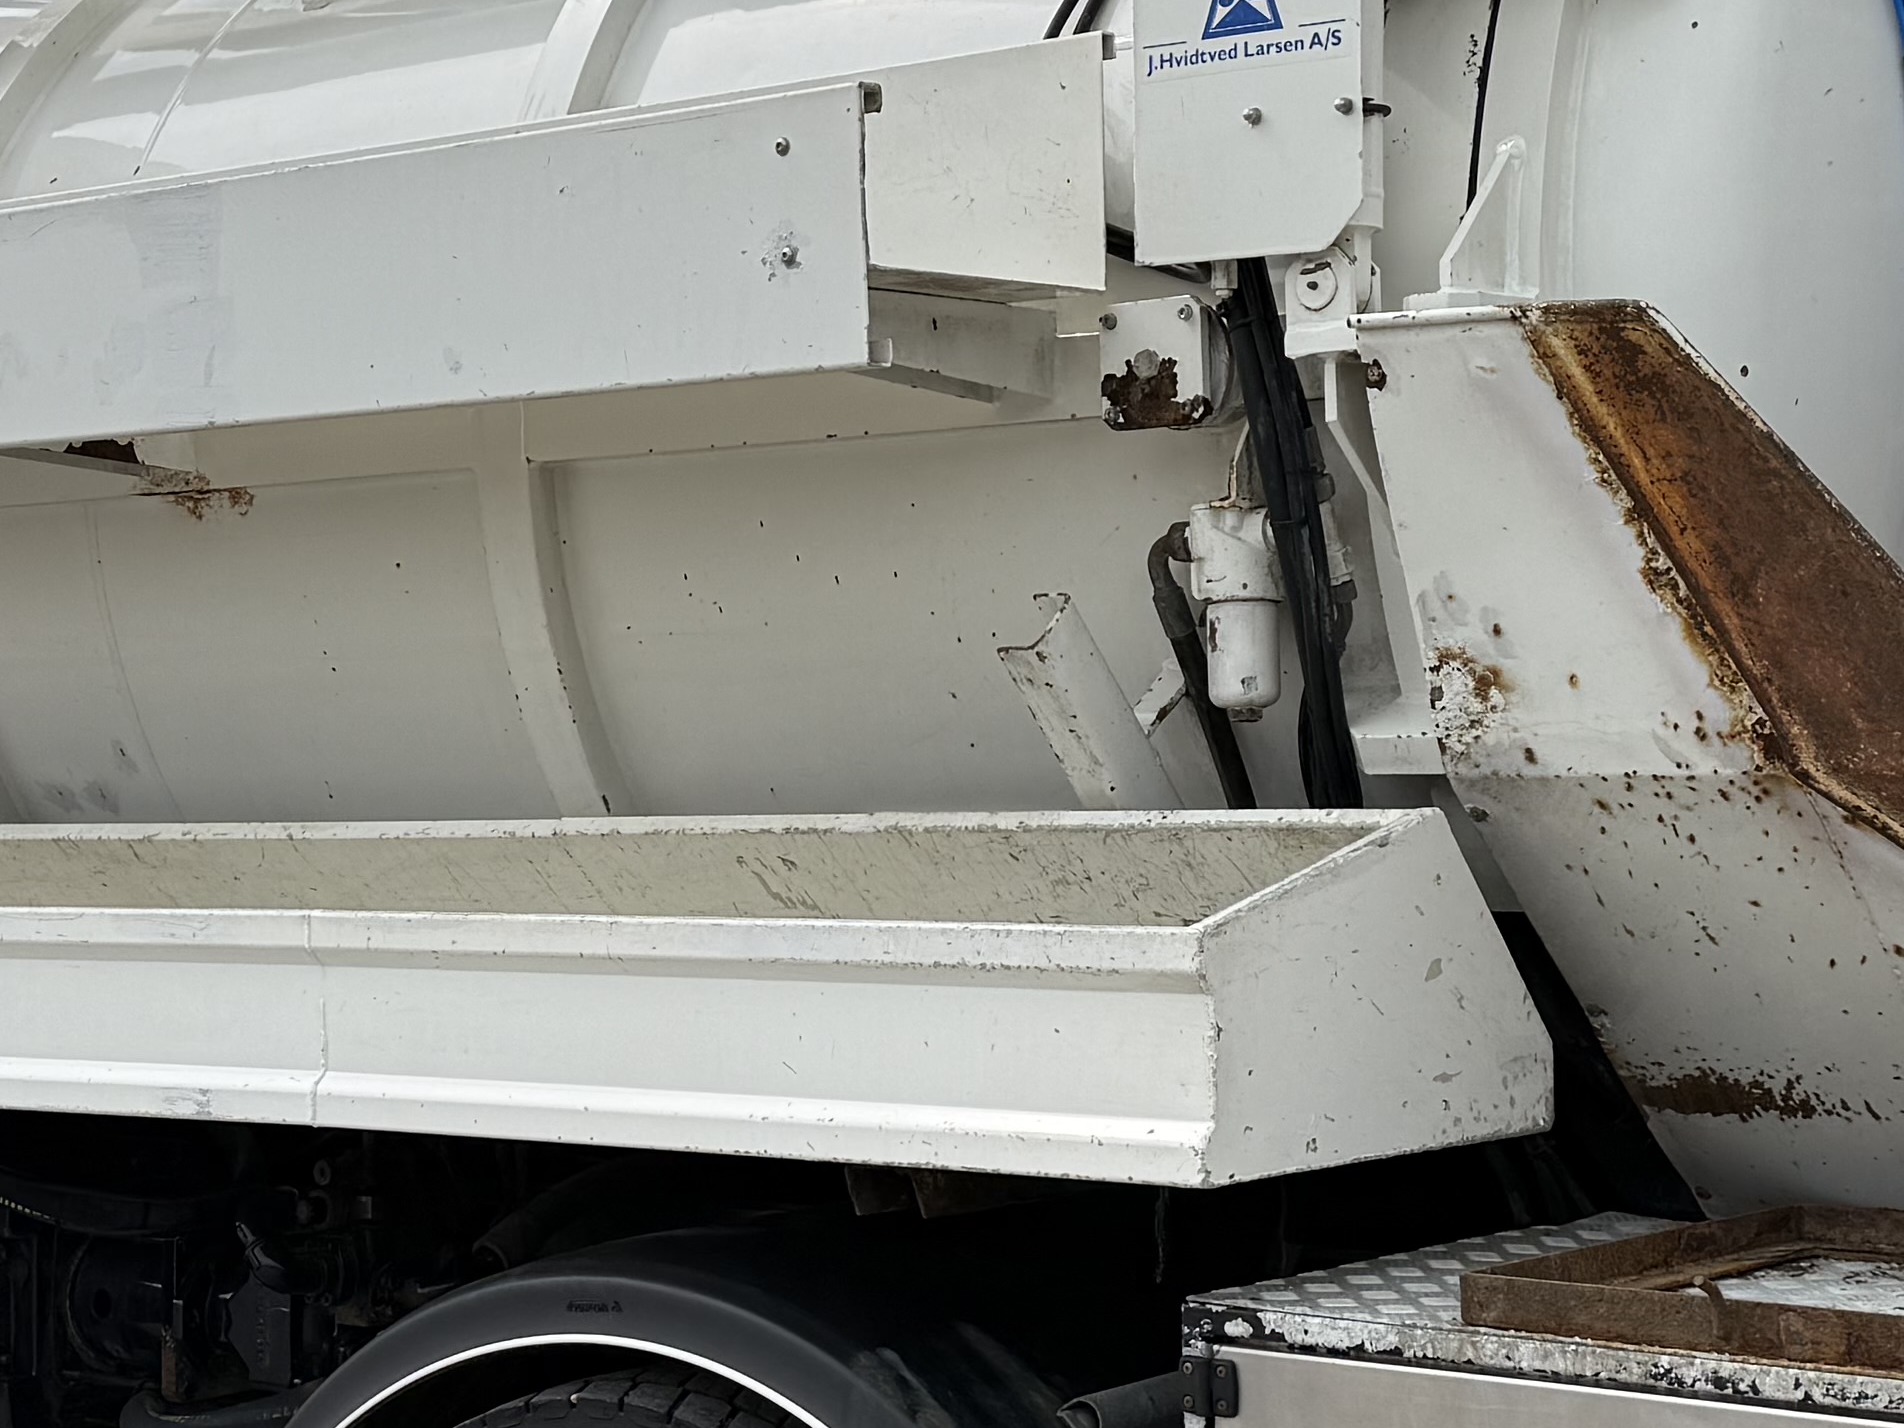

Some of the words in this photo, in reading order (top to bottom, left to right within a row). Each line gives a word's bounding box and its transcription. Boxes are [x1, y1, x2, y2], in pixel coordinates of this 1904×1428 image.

[1146, 42, 1238, 77] J.Hvidtved
[1243, 37, 1305, 58] Larsen
[1308, 27, 1343, 51] A/S
